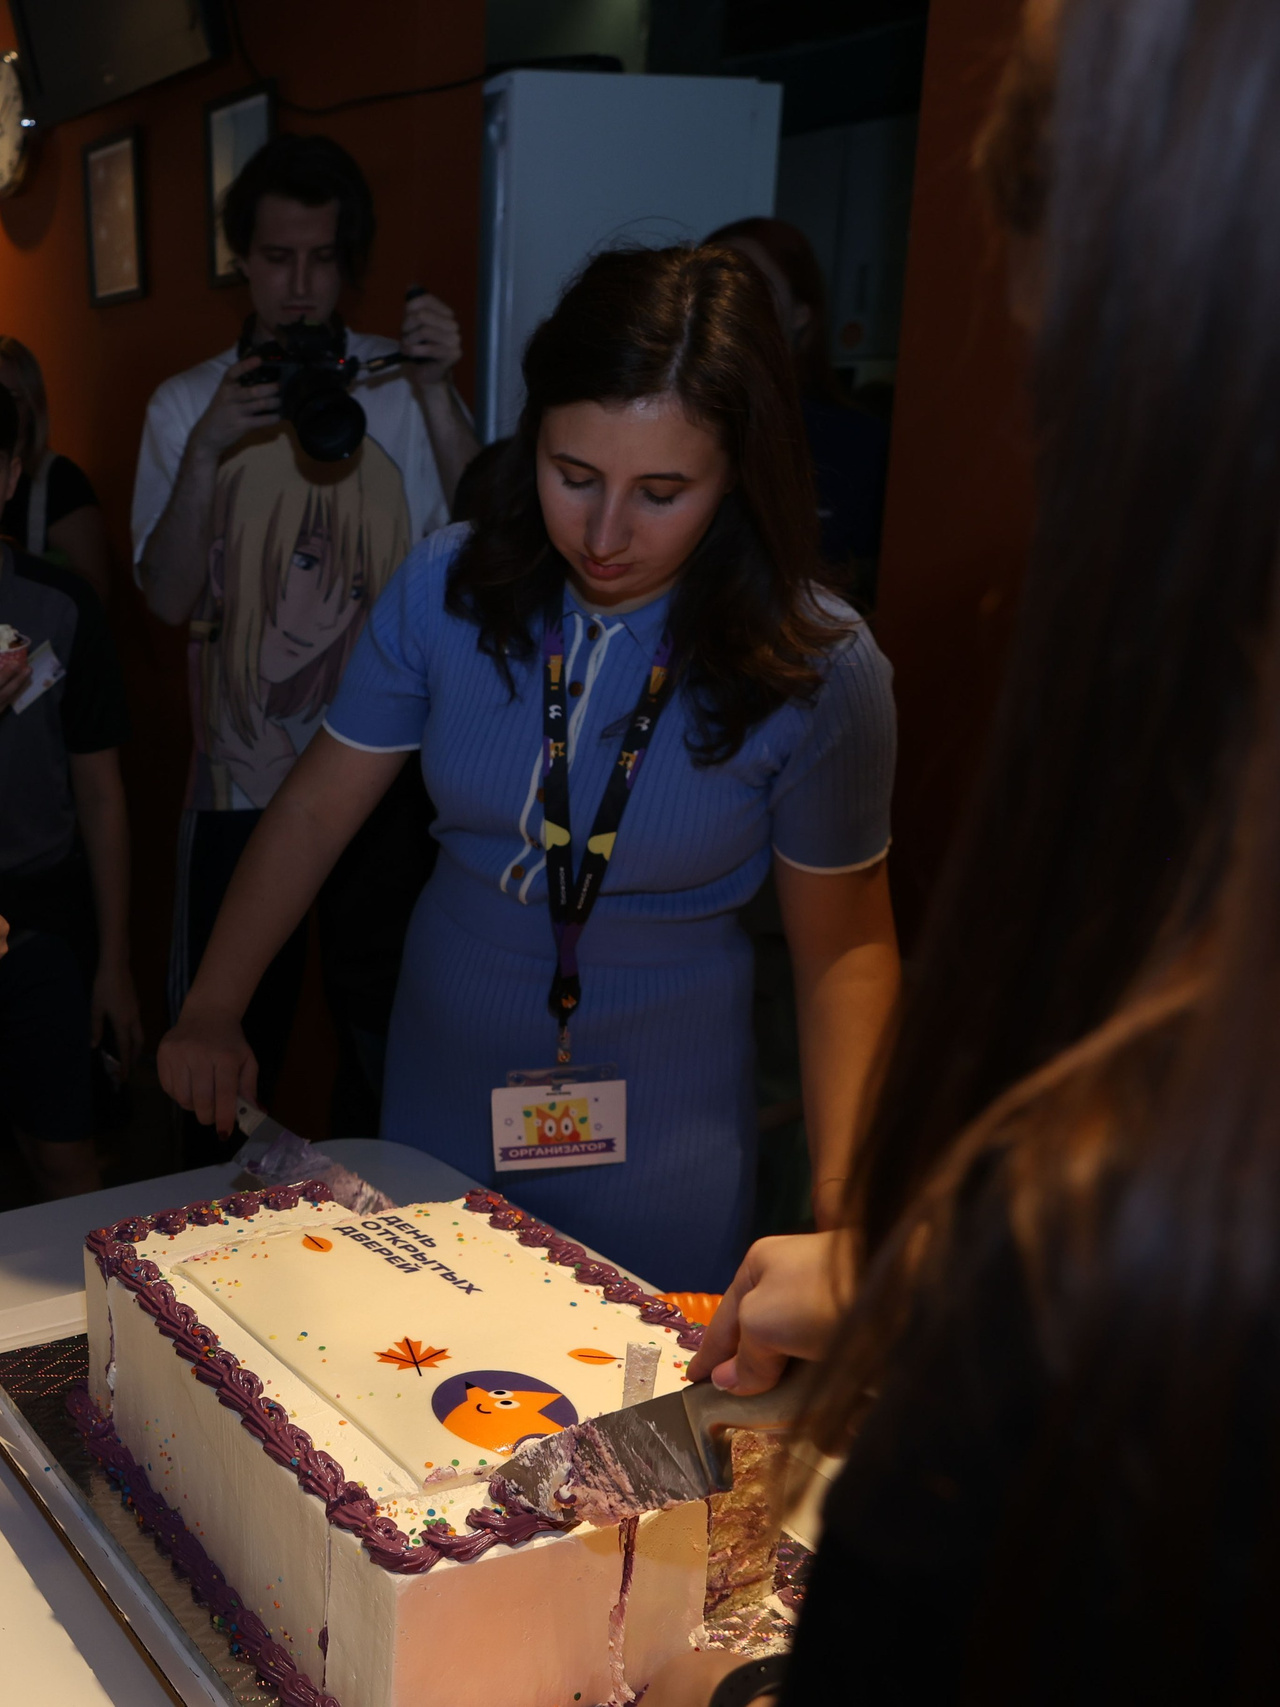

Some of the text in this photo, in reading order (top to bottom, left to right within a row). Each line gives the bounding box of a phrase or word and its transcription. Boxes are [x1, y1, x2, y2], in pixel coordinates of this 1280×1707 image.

[507, 1141, 607, 1159] ОРГАНИЗАТОР
[331, 1225, 423, 1274] ДВЕРЕЙ
[376, 1215, 437, 1248] ДЕНЬ
[360, 1220, 484, 1295] ОТКРЫТЫХ
